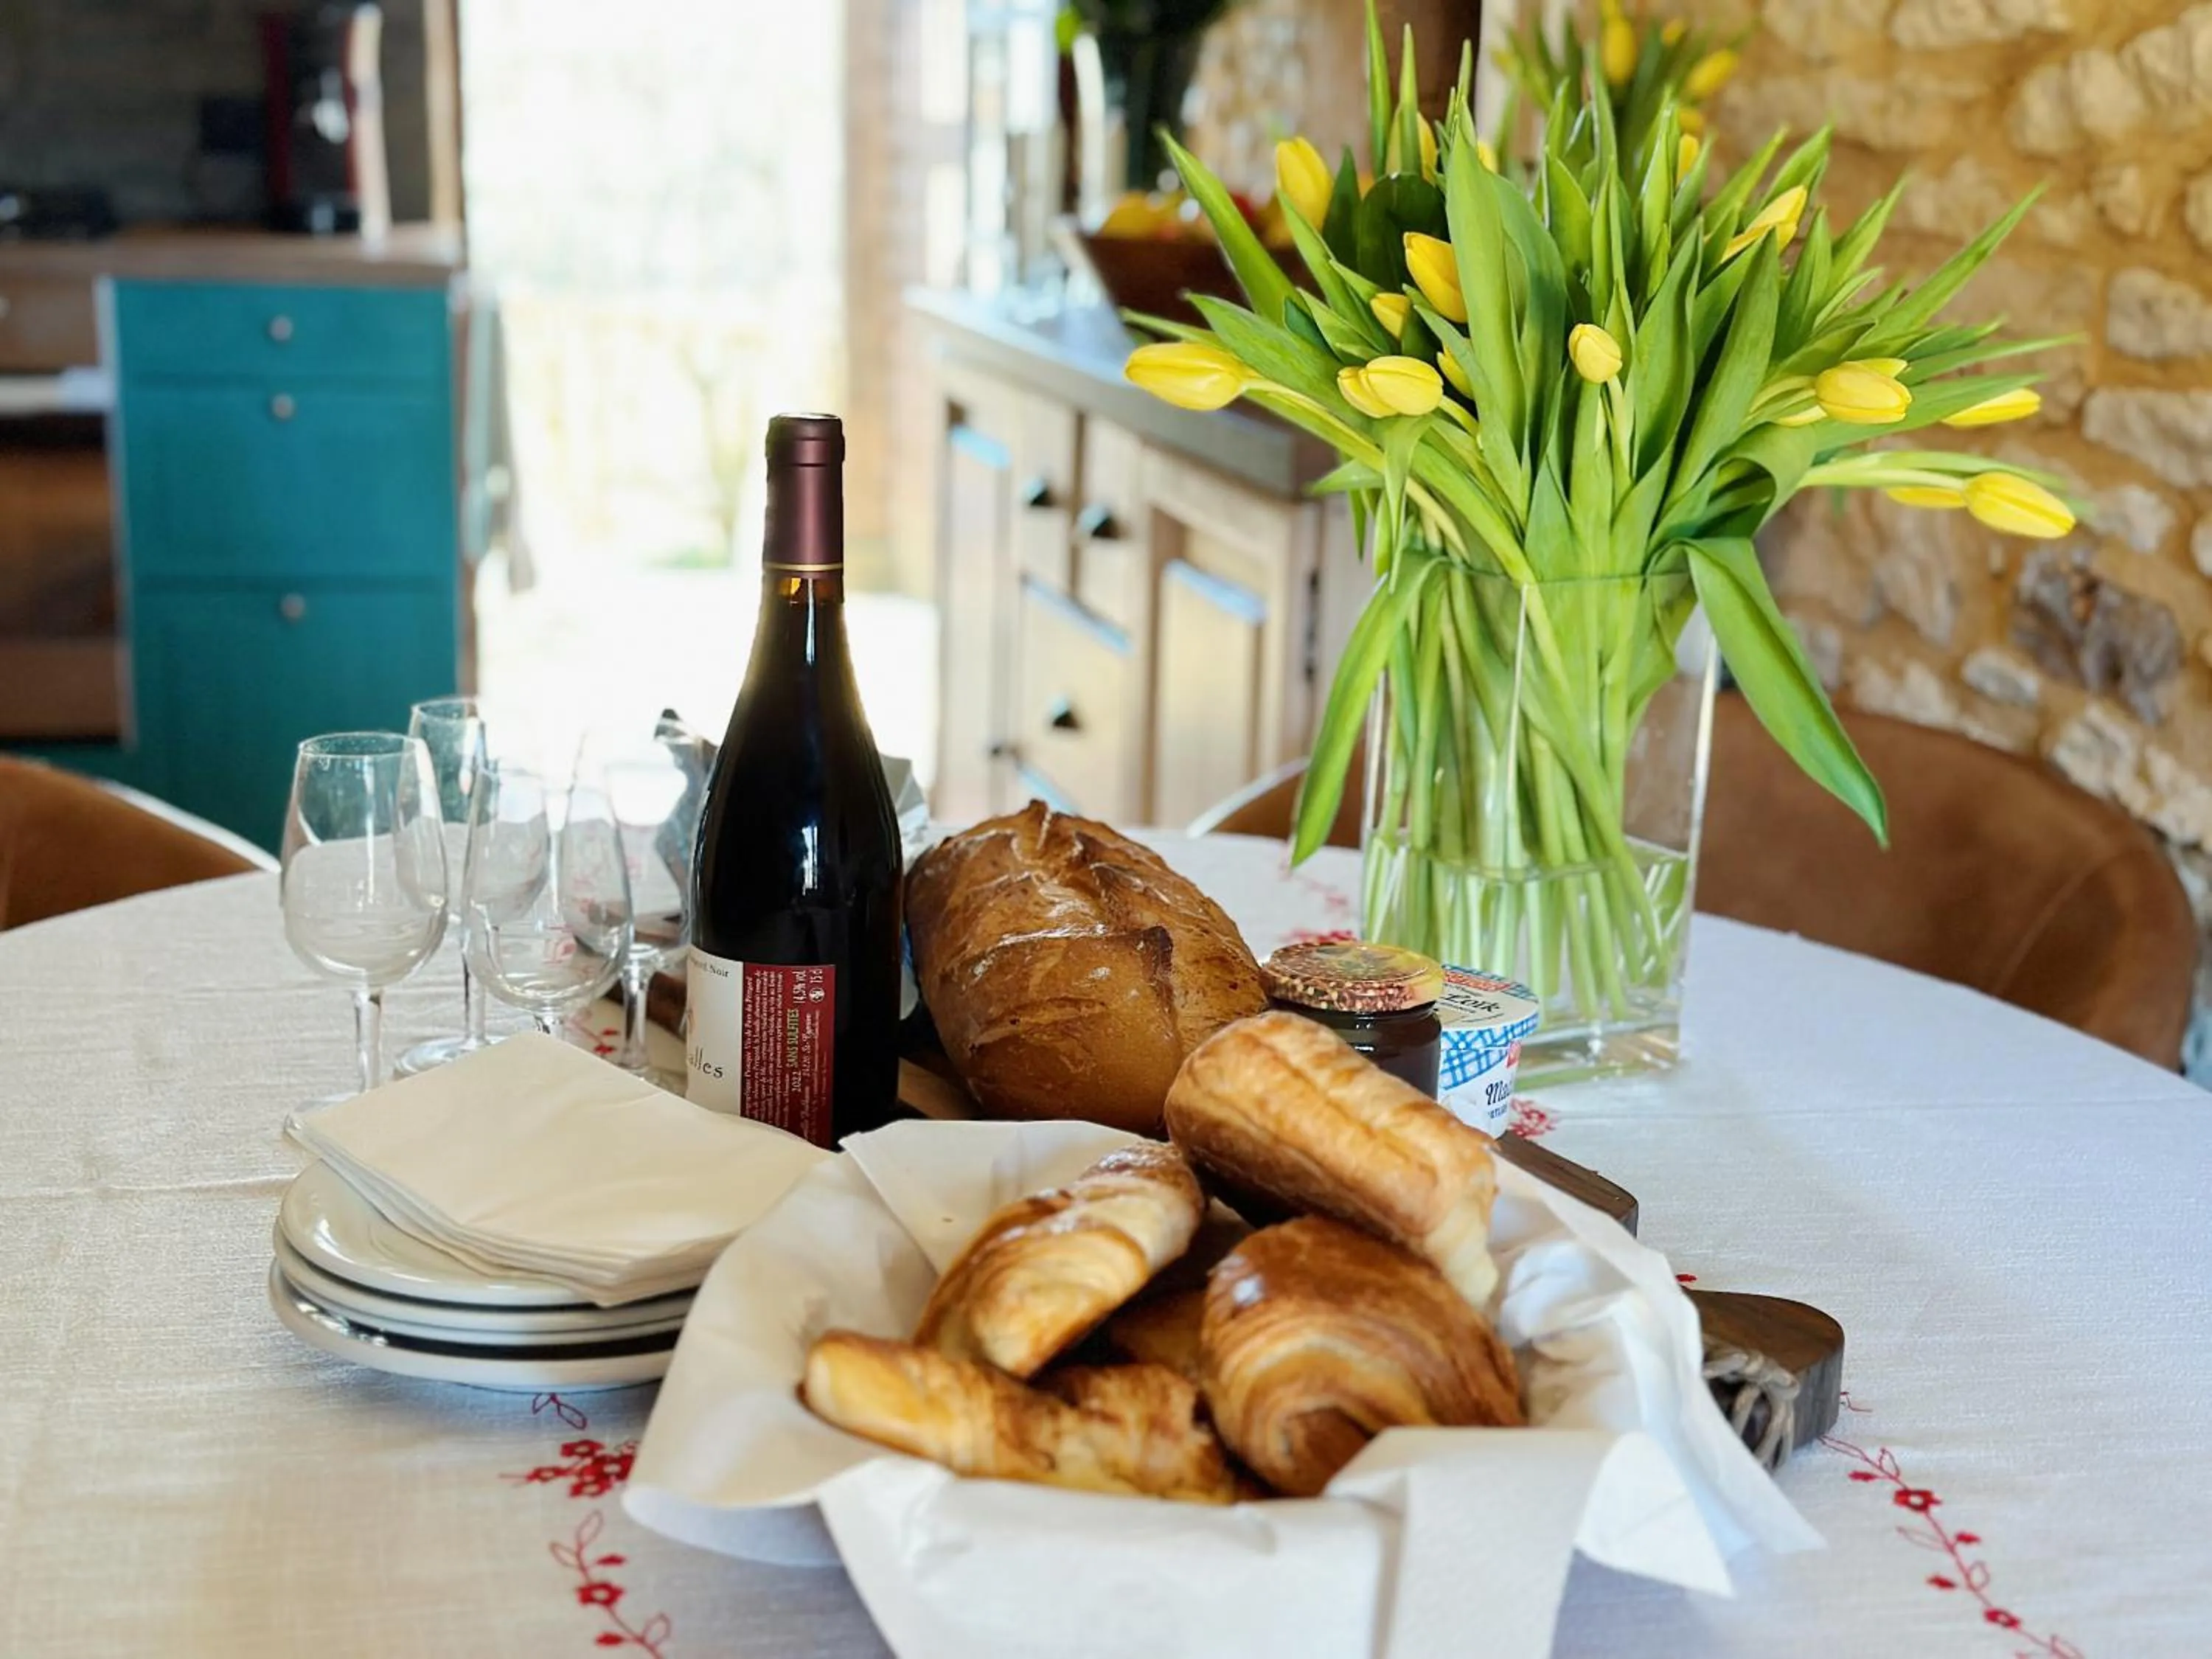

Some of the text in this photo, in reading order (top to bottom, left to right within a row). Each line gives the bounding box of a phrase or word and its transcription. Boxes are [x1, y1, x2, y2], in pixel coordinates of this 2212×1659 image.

[709, 965, 729, 977] Noir
[787, 1009, 799, 1068] SANS SULFITES
